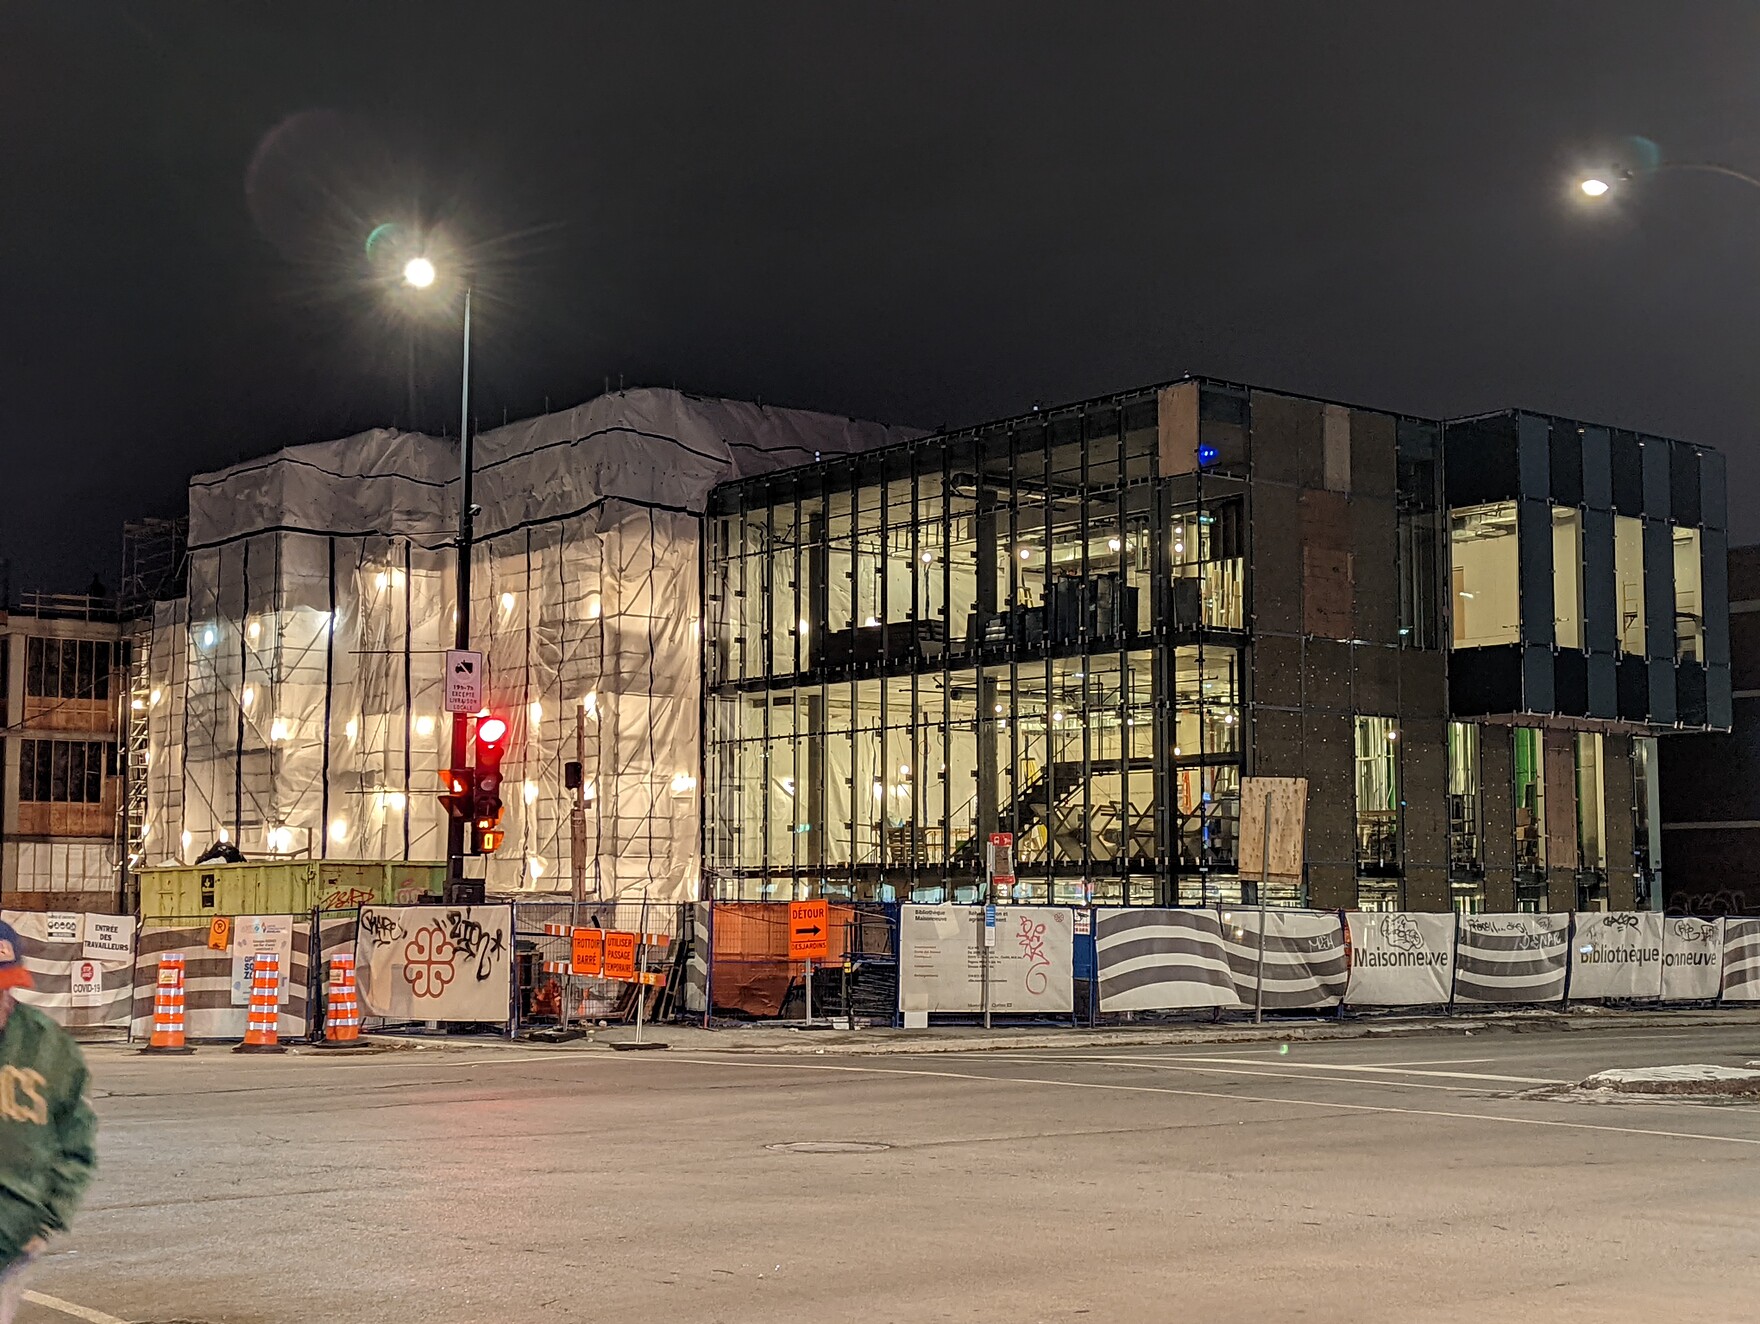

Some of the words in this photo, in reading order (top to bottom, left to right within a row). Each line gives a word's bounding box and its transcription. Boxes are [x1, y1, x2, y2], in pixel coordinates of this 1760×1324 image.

[792, 906, 824, 920] DÉTOUR
[95, 923, 119, 933] ENTRÉE
[99, 933, 112, 942] DES
[574, 937, 600, 949] TROTTOIR
[607, 937, 632, 948] UTILISER
[84, 940, 129, 951] TRAVAILLEURS
[792, 942, 826, 950] DESJARDINS
[576, 952, 597, 965] BARRÉ
[607, 950, 631, 960] PASSAGE
[1354, 946, 1448, 967] Maisonneuve
[1581, 944, 1659, 967] Bibliothèque
[606, 962, 632, 973] TEMPORAIRE
[72, 984, 101, 993] COVID-19
